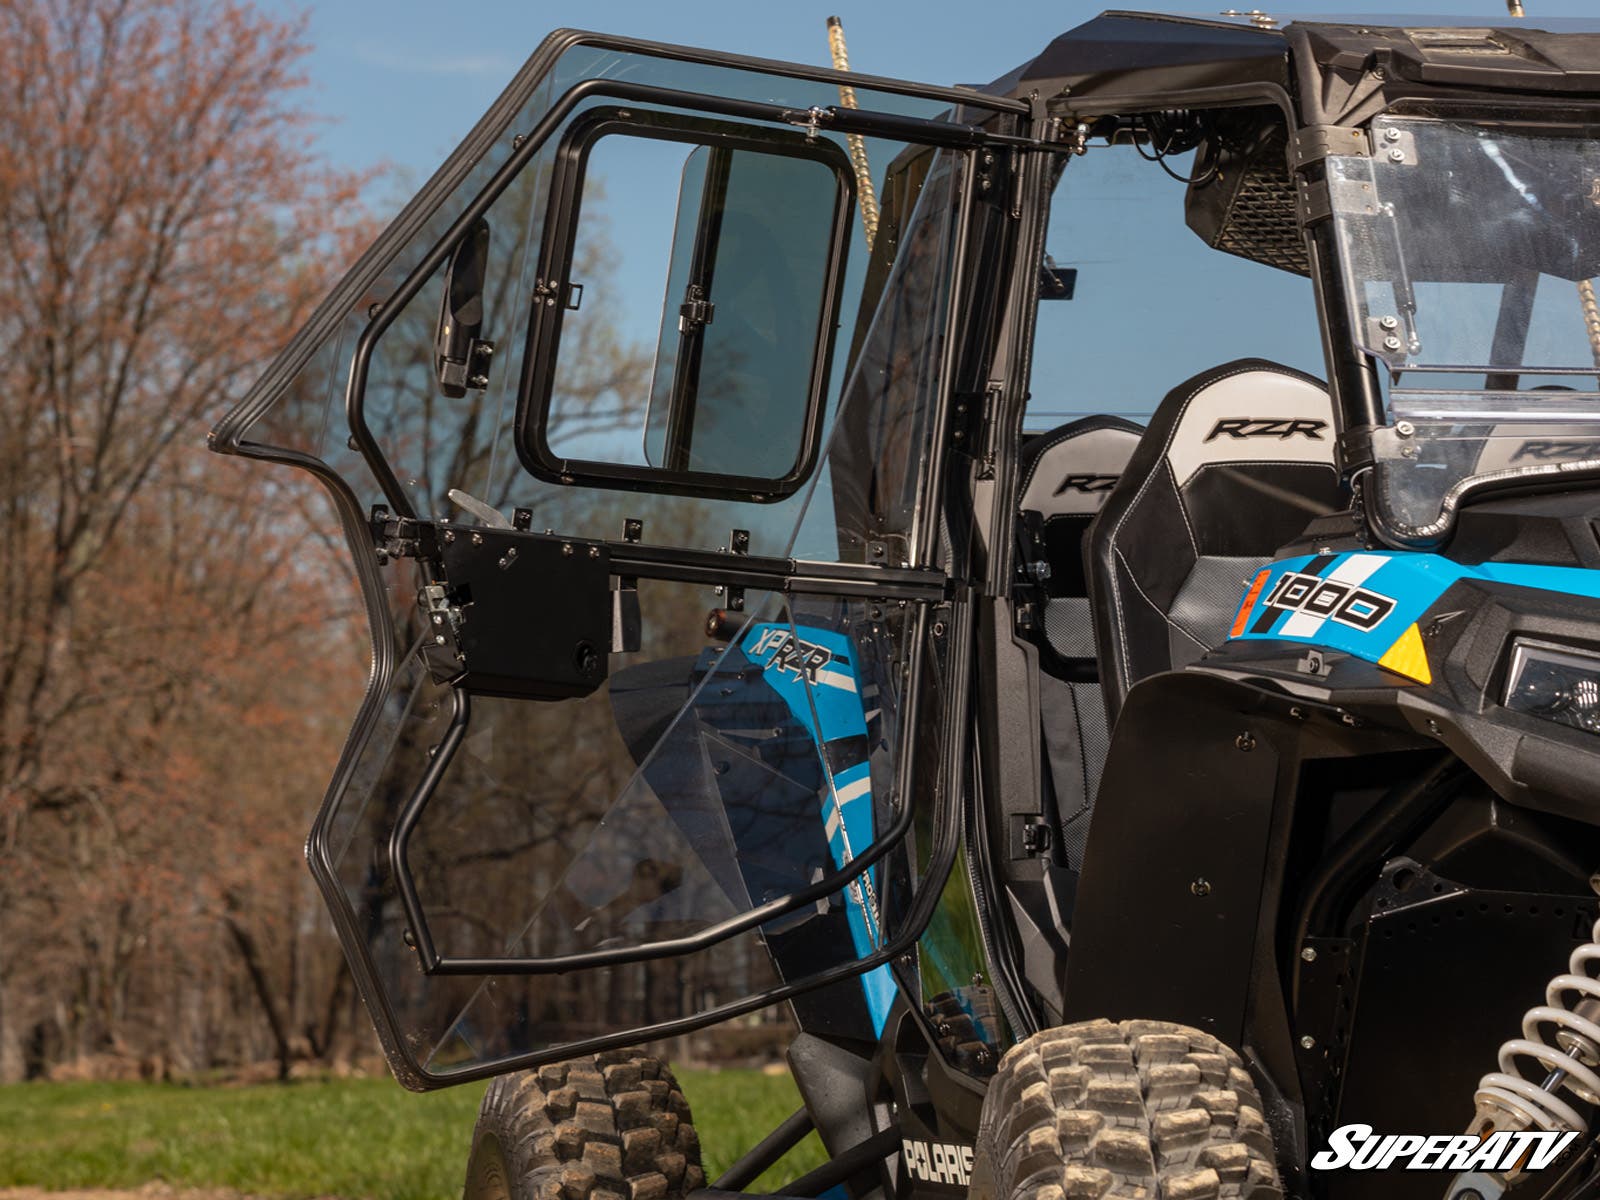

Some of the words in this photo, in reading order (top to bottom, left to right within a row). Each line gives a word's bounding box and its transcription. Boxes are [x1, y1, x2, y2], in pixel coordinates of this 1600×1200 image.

[1202, 416, 1329, 444] RZR
[1053, 473, 1122, 497] RZ
[1262, 571, 1398, 633] 1000
[749, 627, 791, 656] XP
[764, 635, 832, 686] RZR
[902, 1139, 974, 1186] POLARIS
